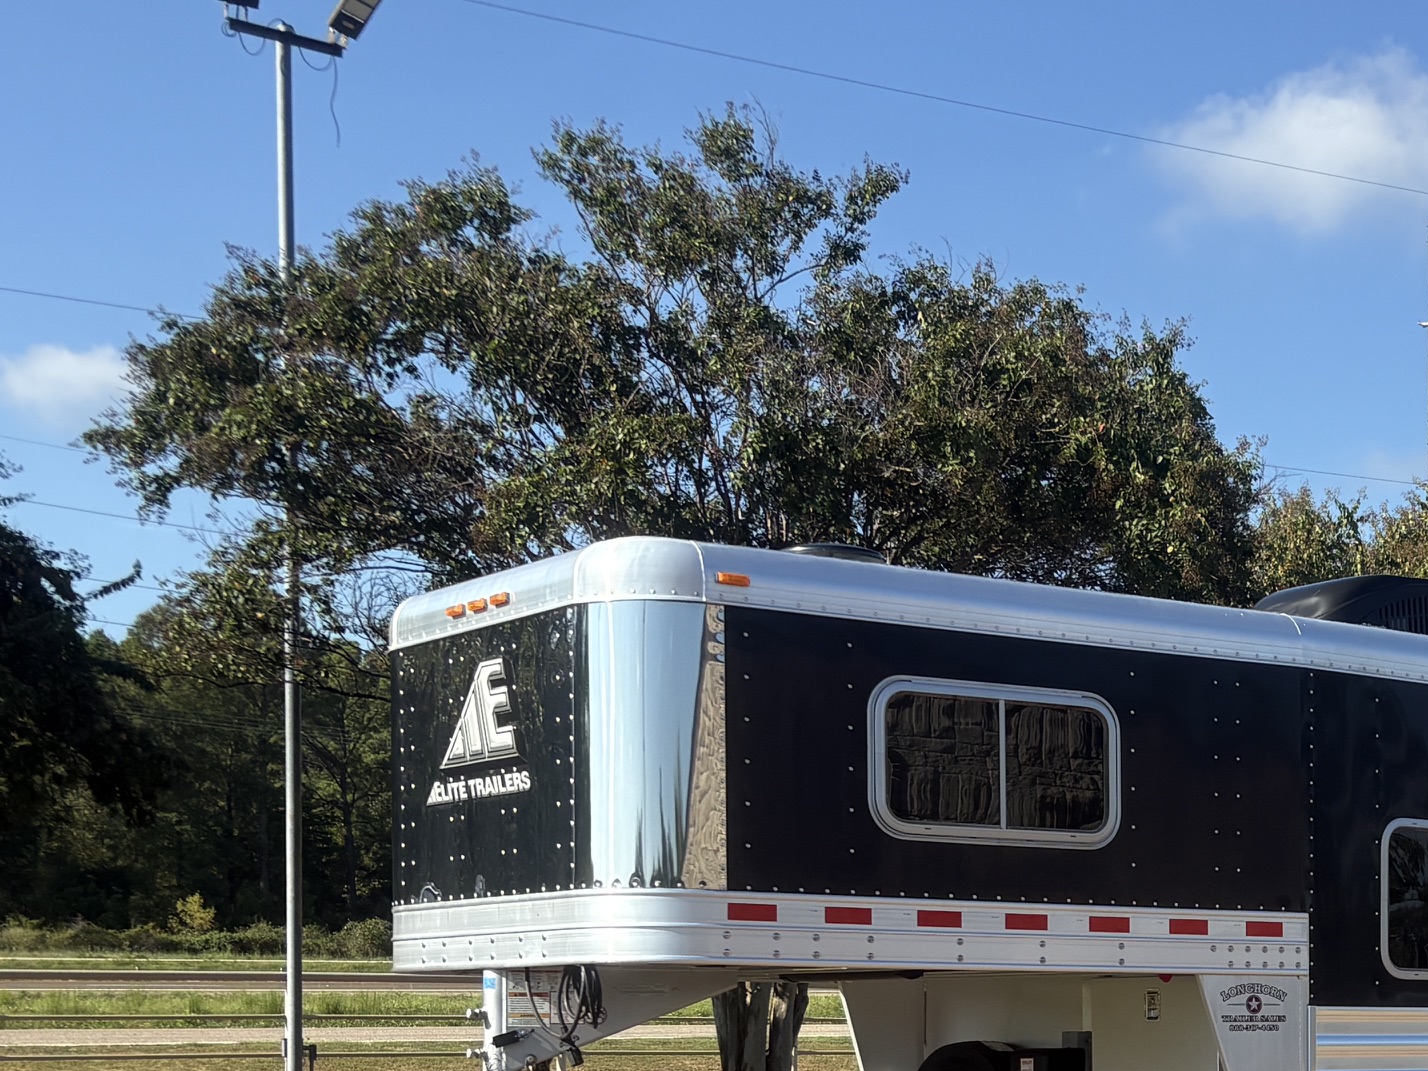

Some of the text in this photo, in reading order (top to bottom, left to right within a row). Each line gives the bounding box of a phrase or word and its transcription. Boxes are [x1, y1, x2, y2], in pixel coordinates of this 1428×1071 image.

[427, 771, 531, 806] ELITE TRAILERS
[1220, 983, 1287, 1002] LONGHORN
